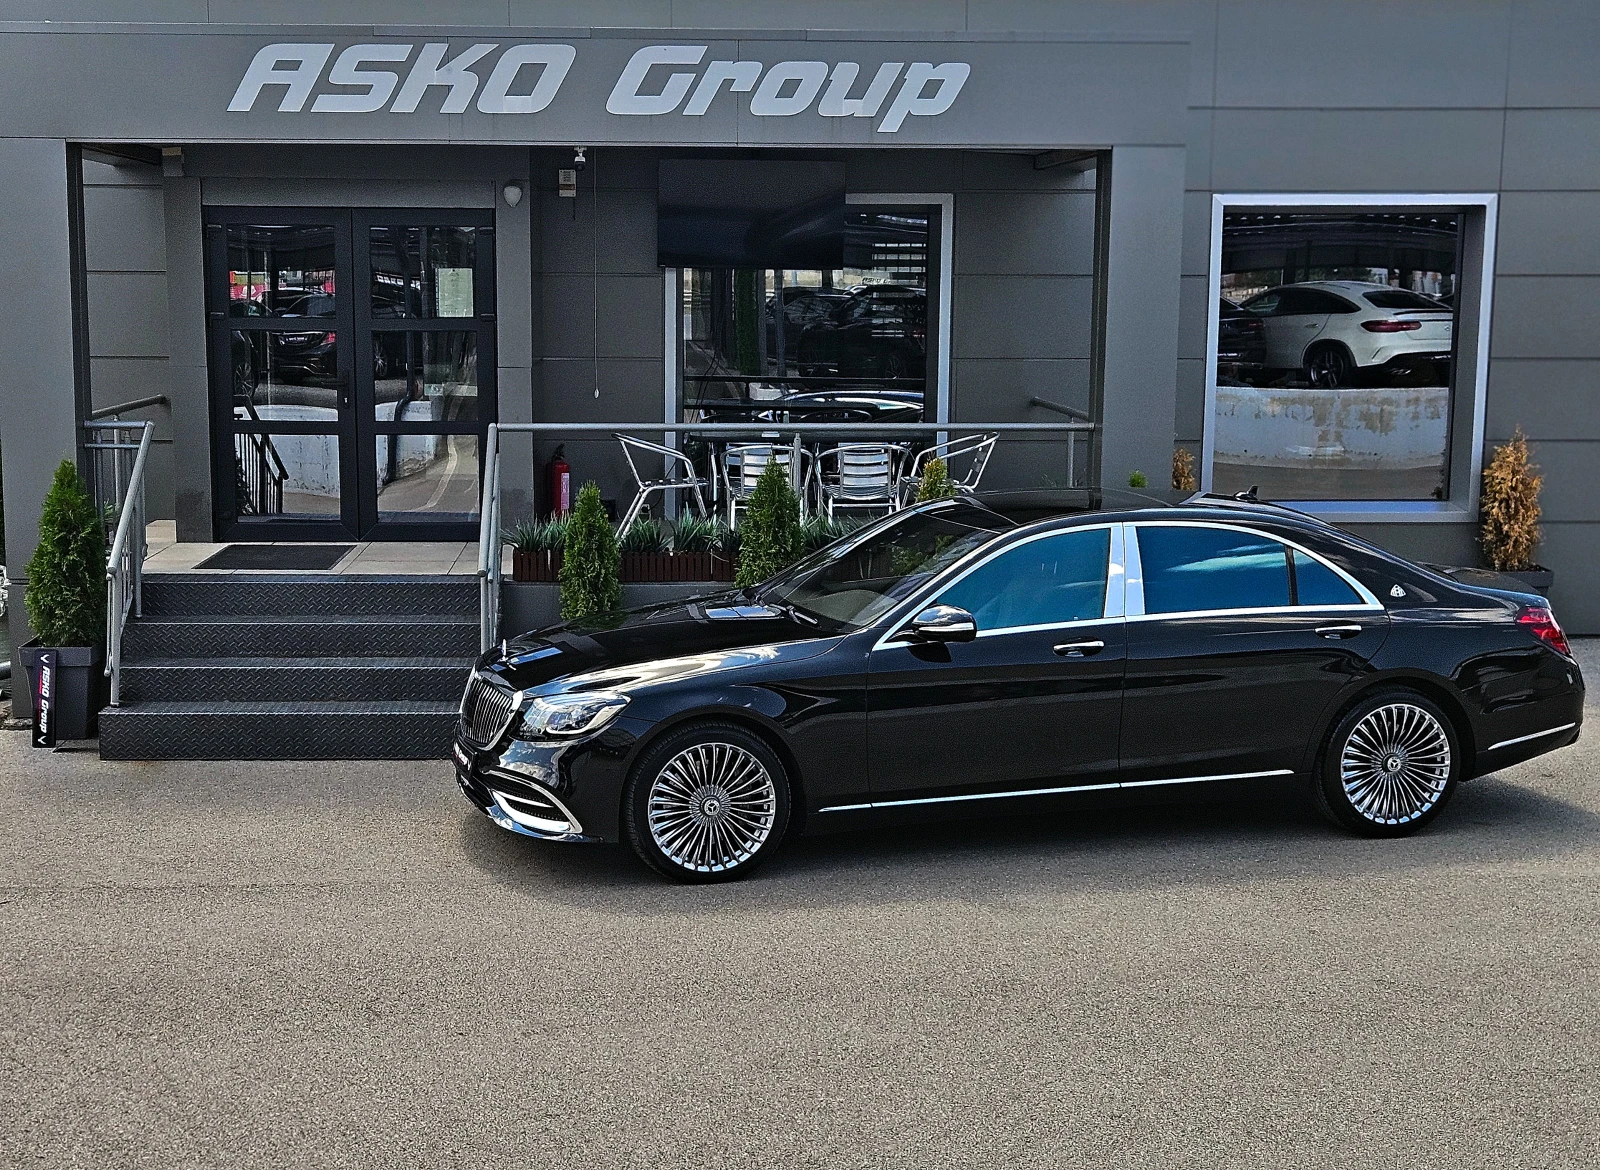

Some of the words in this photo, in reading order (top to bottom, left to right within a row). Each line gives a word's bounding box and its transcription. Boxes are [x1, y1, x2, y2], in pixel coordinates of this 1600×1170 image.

[227, 43, 577, 114] ASKO
[605, 45, 972, 133] Group
[42, 665, 50, 698] ASKO
[39, 699, 49, 733] Group
